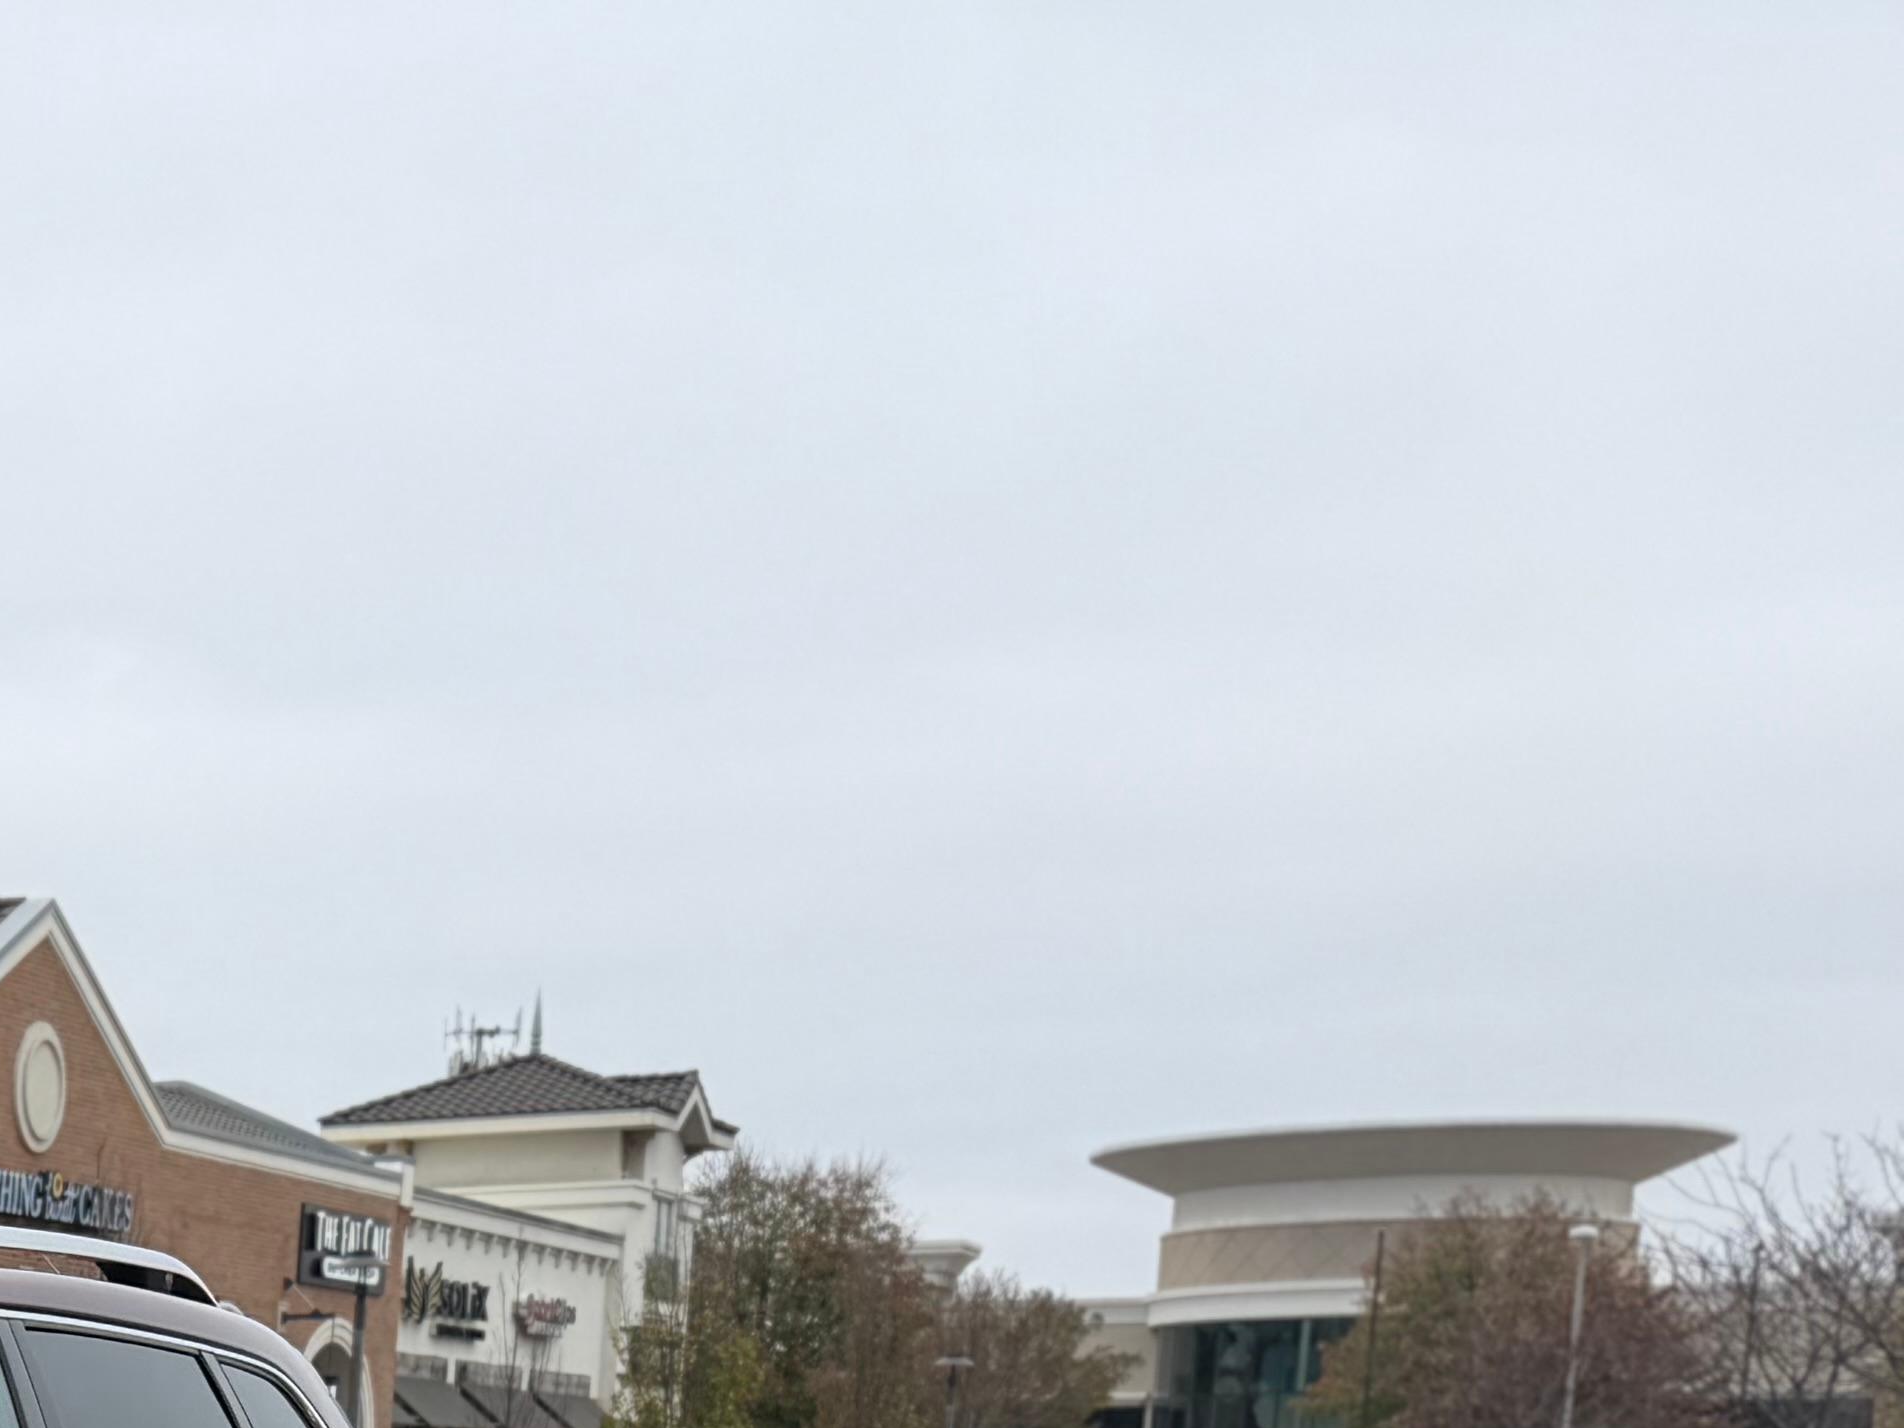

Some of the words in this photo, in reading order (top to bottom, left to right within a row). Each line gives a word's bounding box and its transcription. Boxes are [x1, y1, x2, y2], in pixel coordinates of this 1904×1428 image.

[78, 1183, 135, 1232] CAKES
[316, 1210, 339, 1252] THE
[340, 1215, 362, 1257] FAT
